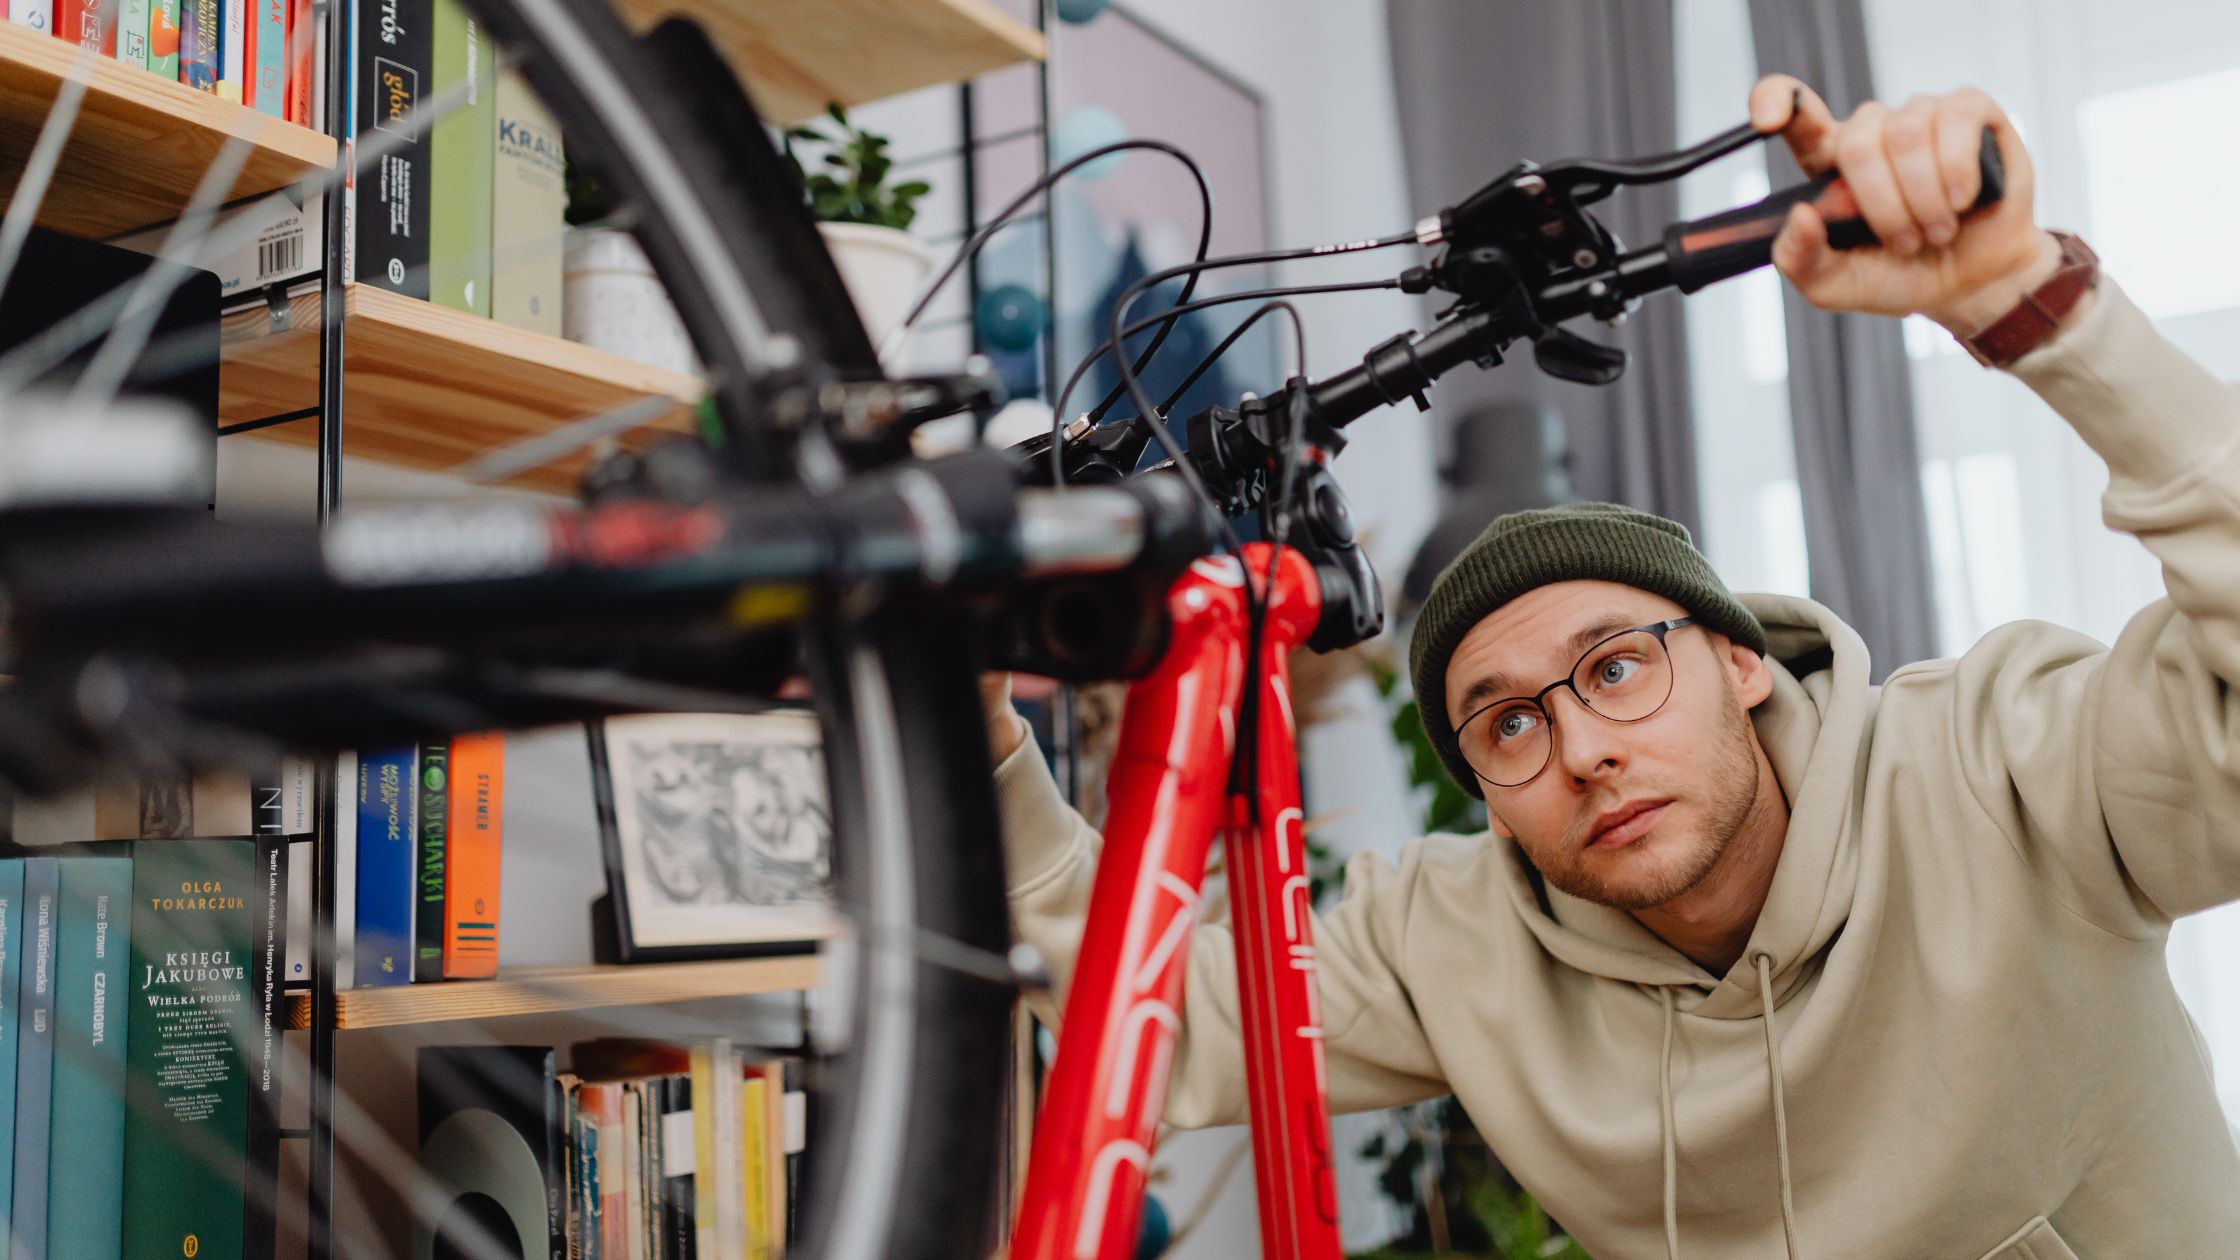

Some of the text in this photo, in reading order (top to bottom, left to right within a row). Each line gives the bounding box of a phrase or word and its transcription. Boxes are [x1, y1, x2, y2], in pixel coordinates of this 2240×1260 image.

[420, 793, 445, 902] SUCHARKI
[270, 849, 278, 871] Teatr
[182, 882, 222, 894] OLGA
[269, 873, 278, 897] Lalek
[152, 897, 244, 911] TOKARCZUK
[268, 898, 276, 929] Arlekin
[96, 922, 108, 958] Brown
[36, 927, 50, 994] Wiśniewska
[166, 951, 230, 967] KSIĘGI
[265, 944, 275, 981] Henryka
[142, 965, 244, 989] JAKUBOWE
[148, 996, 196, 1007] WIELKA
[264, 982, 274, 1002] Ryla
[93, 972, 106, 1046] CZARNOBYL
[264, 1003, 271, 1011] w
[34, 1009, 46, 1033] LUD
[264, 1012, 273, 1037] Łodzi
